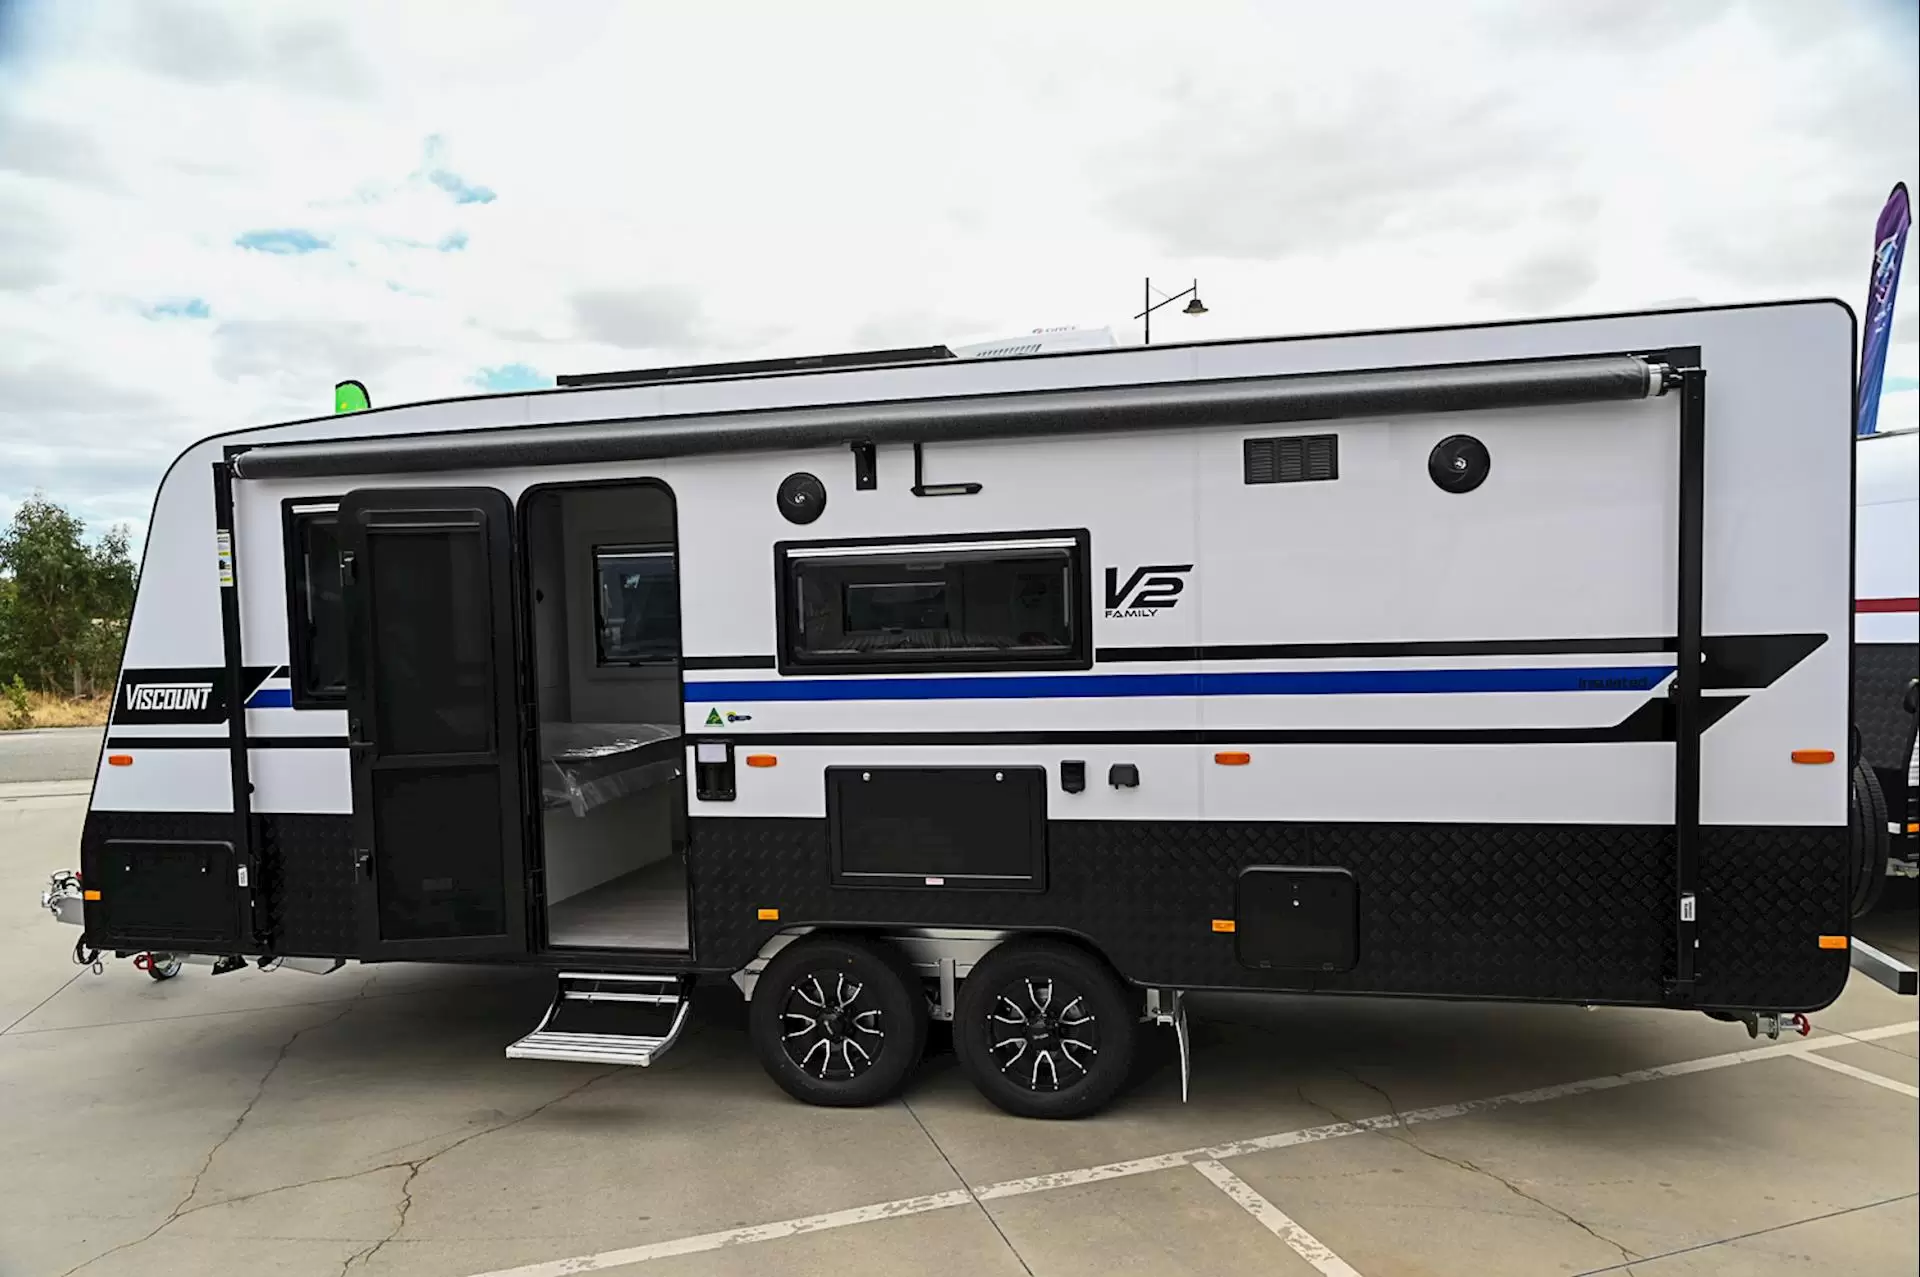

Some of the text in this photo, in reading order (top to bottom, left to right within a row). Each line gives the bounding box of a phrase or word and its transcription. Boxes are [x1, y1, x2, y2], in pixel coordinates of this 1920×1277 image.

[1105, 564, 1194, 609] V2
[1105, 609, 1158, 618] FAMILY
[126, 683, 213, 710] VISCOUNT
